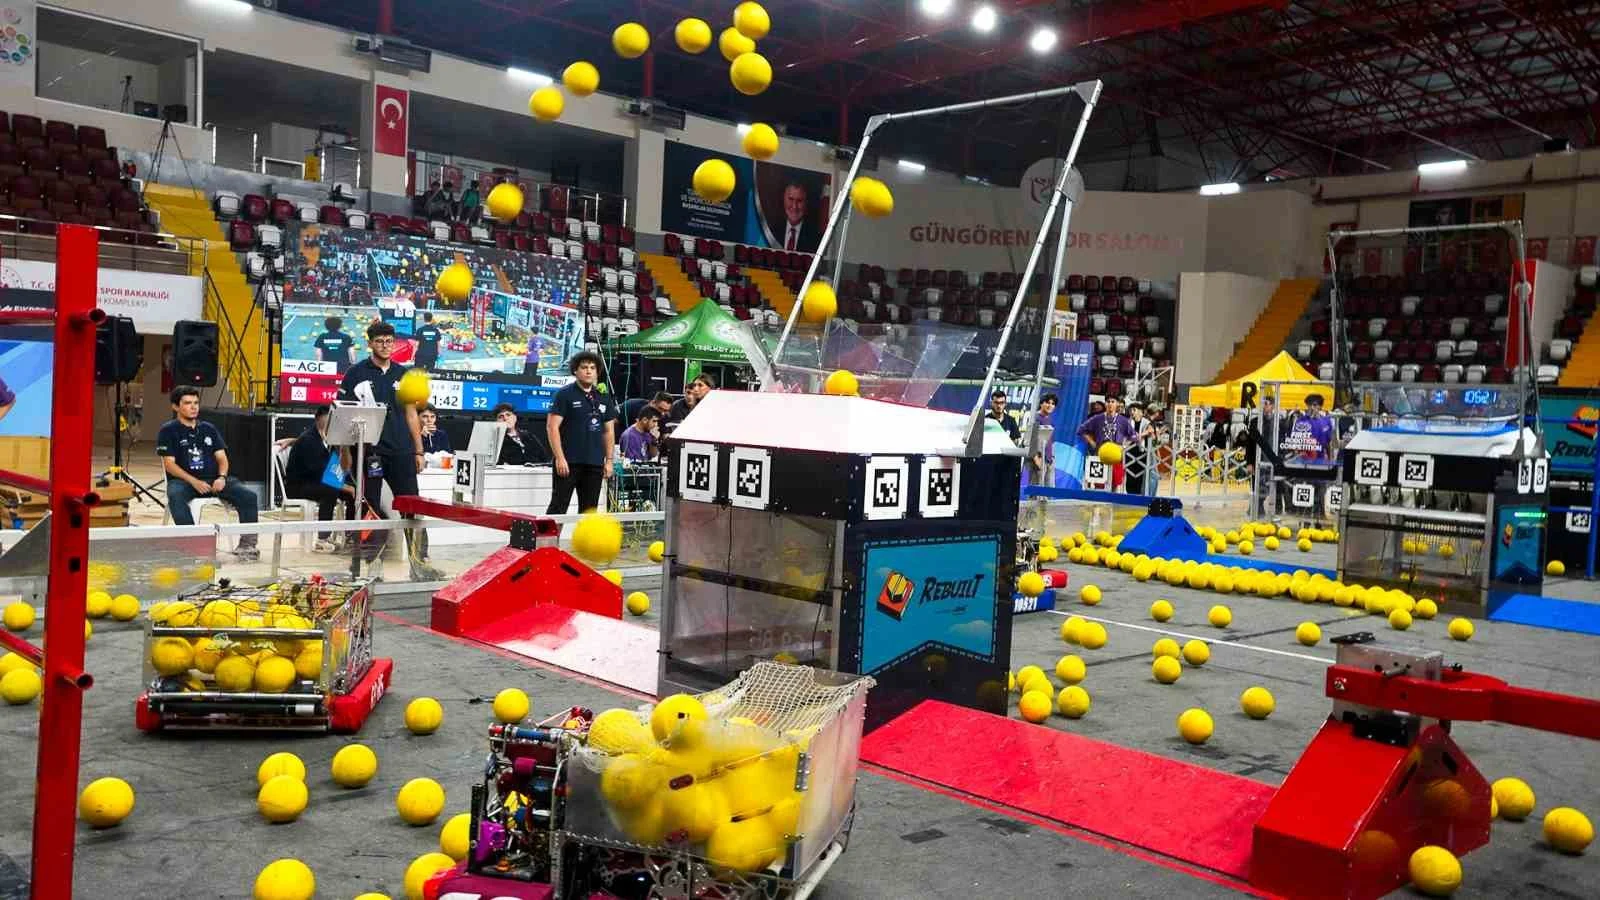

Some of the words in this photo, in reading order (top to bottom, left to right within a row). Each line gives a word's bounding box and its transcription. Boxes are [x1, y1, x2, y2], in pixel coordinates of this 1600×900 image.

[909, 223, 1030, 247] GÜNGÖREN
[432, 395, 458, 407] 1:42
[473, 397, 488, 408] 32
[1241, 381, 1257, 408] R
[919, 573, 985, 605] REBUILT
